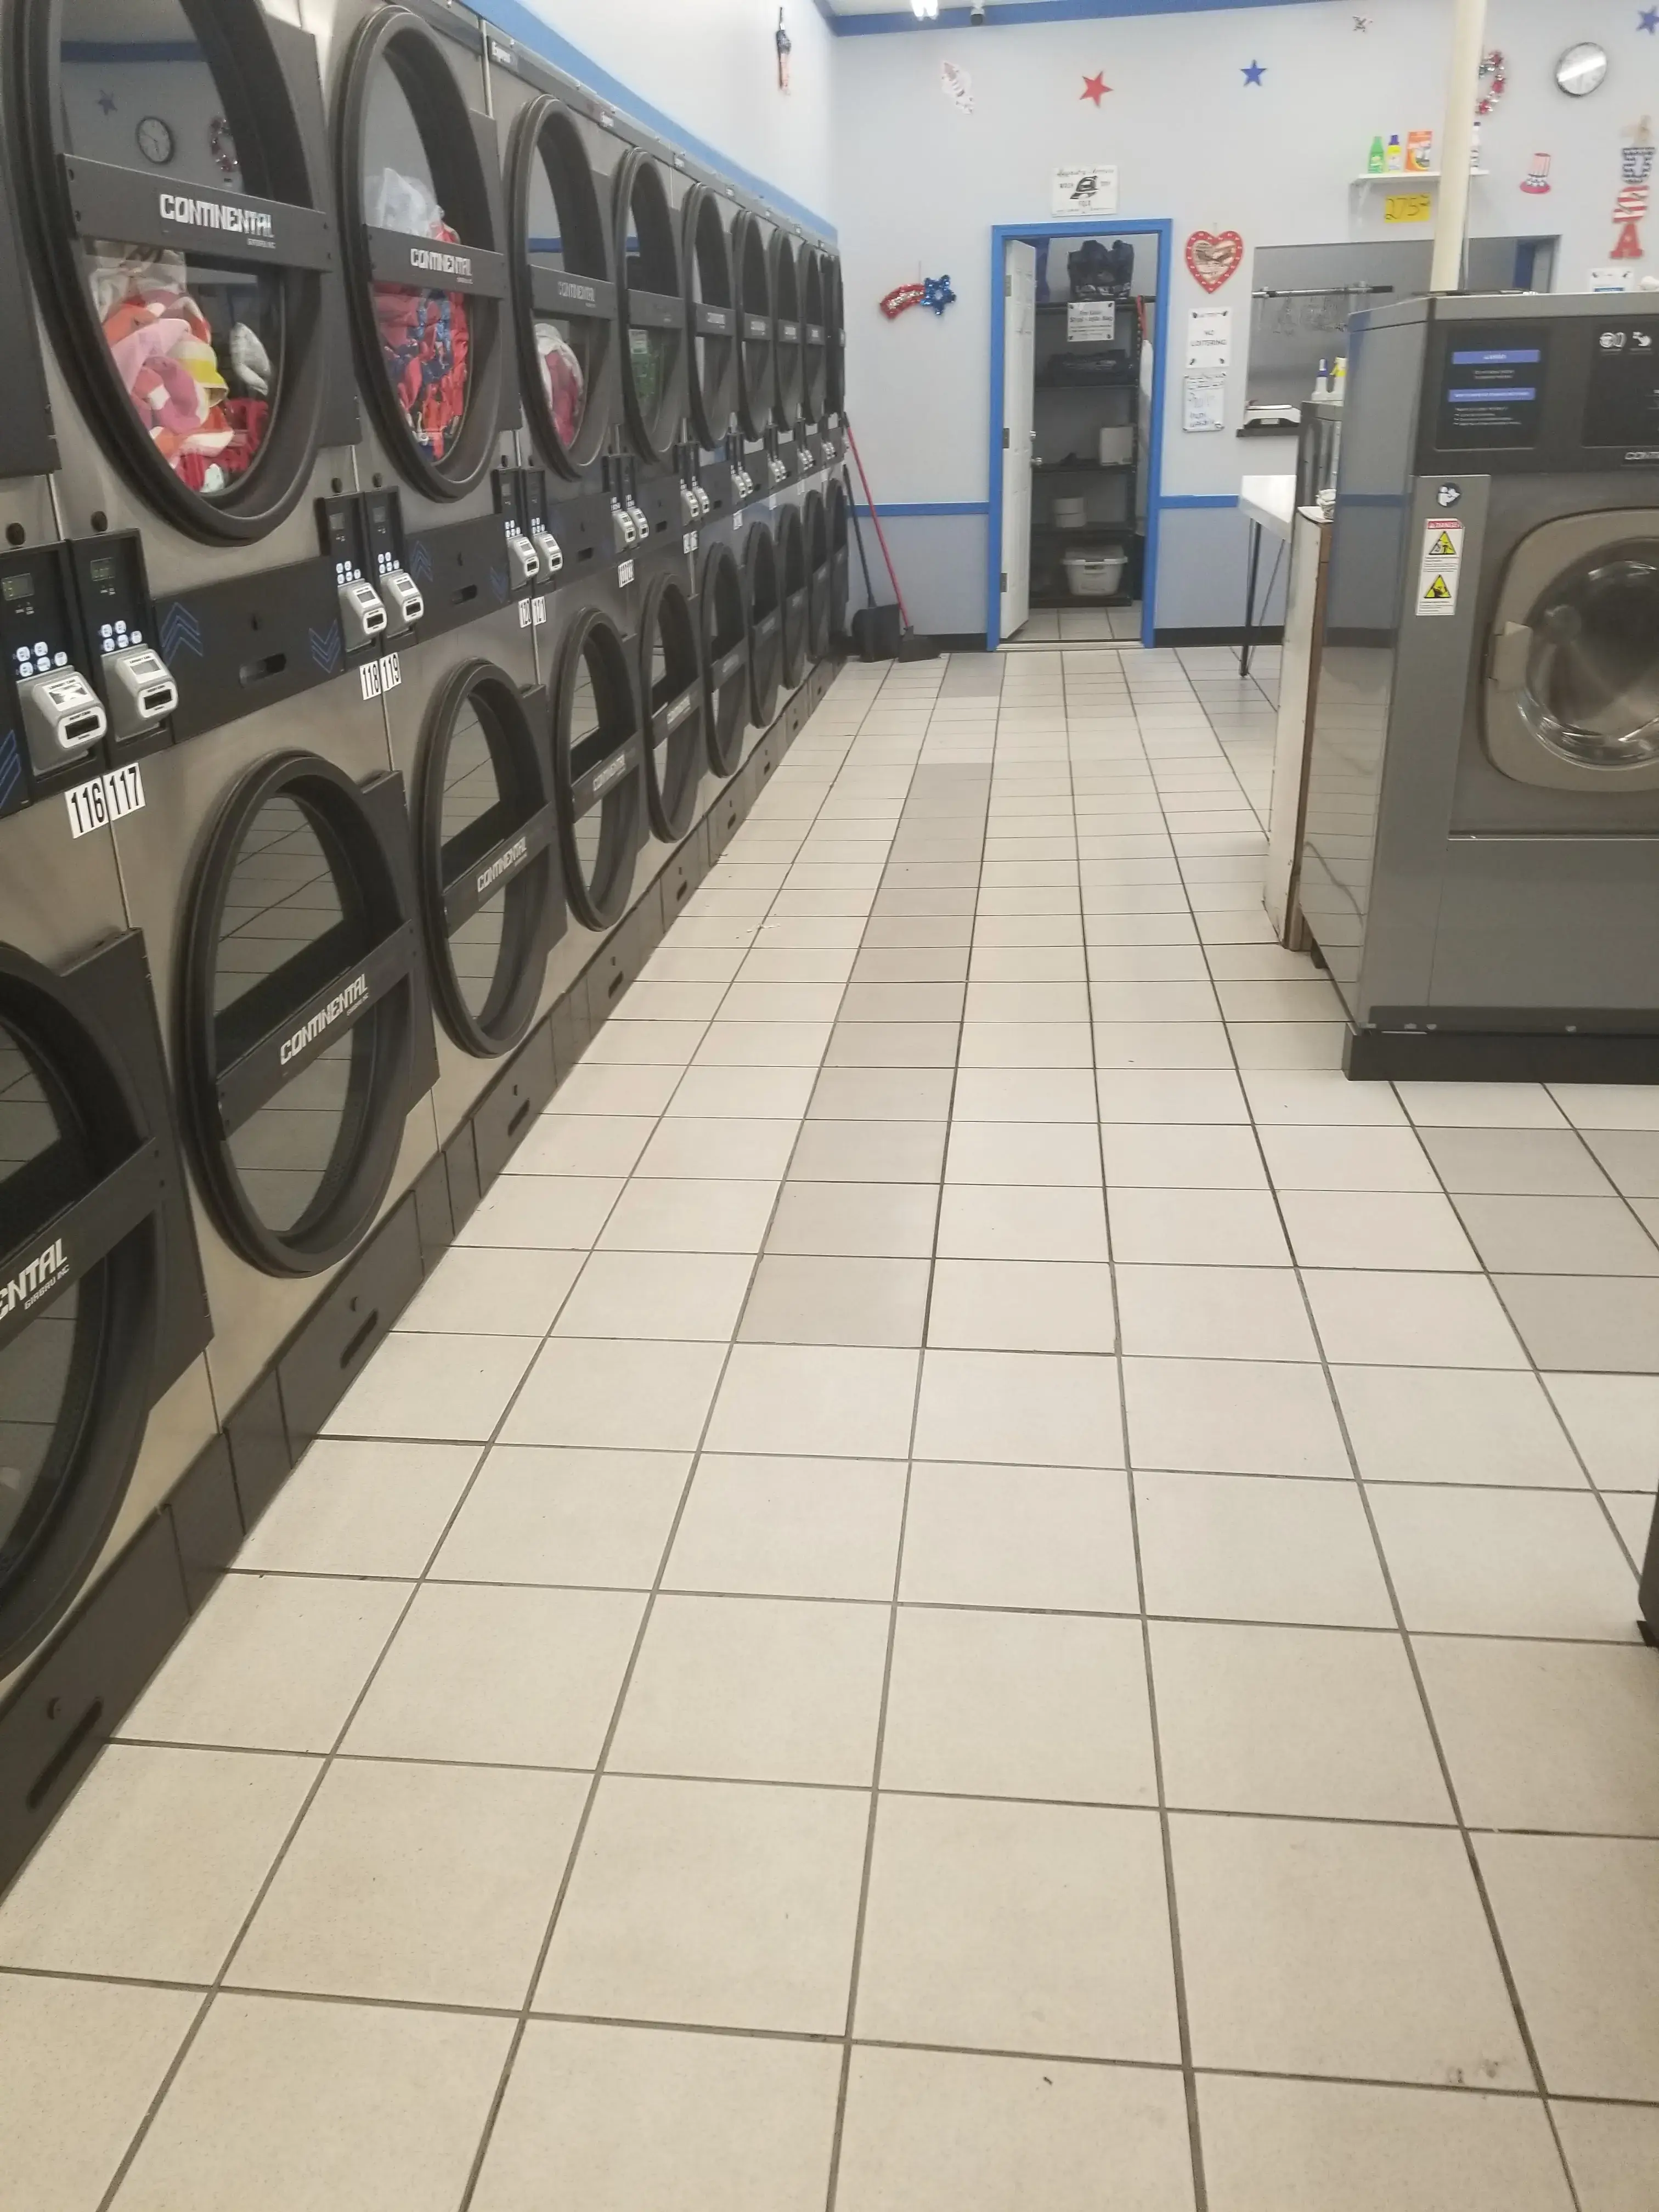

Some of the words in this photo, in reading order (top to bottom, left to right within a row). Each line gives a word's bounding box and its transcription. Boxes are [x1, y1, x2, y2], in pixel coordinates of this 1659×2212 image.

[160, 194, 274, 238] CONTINENTAL
[411, 249, 472, 275] CONTINENTAL
[363, 663, 379, 697] 118
[383, 654, 399, 688] 119
[71, 782, 105, 833] 116
[110, 766, 139, 815] 117
[280, 973, 368, 1065] CONTINENTAL
